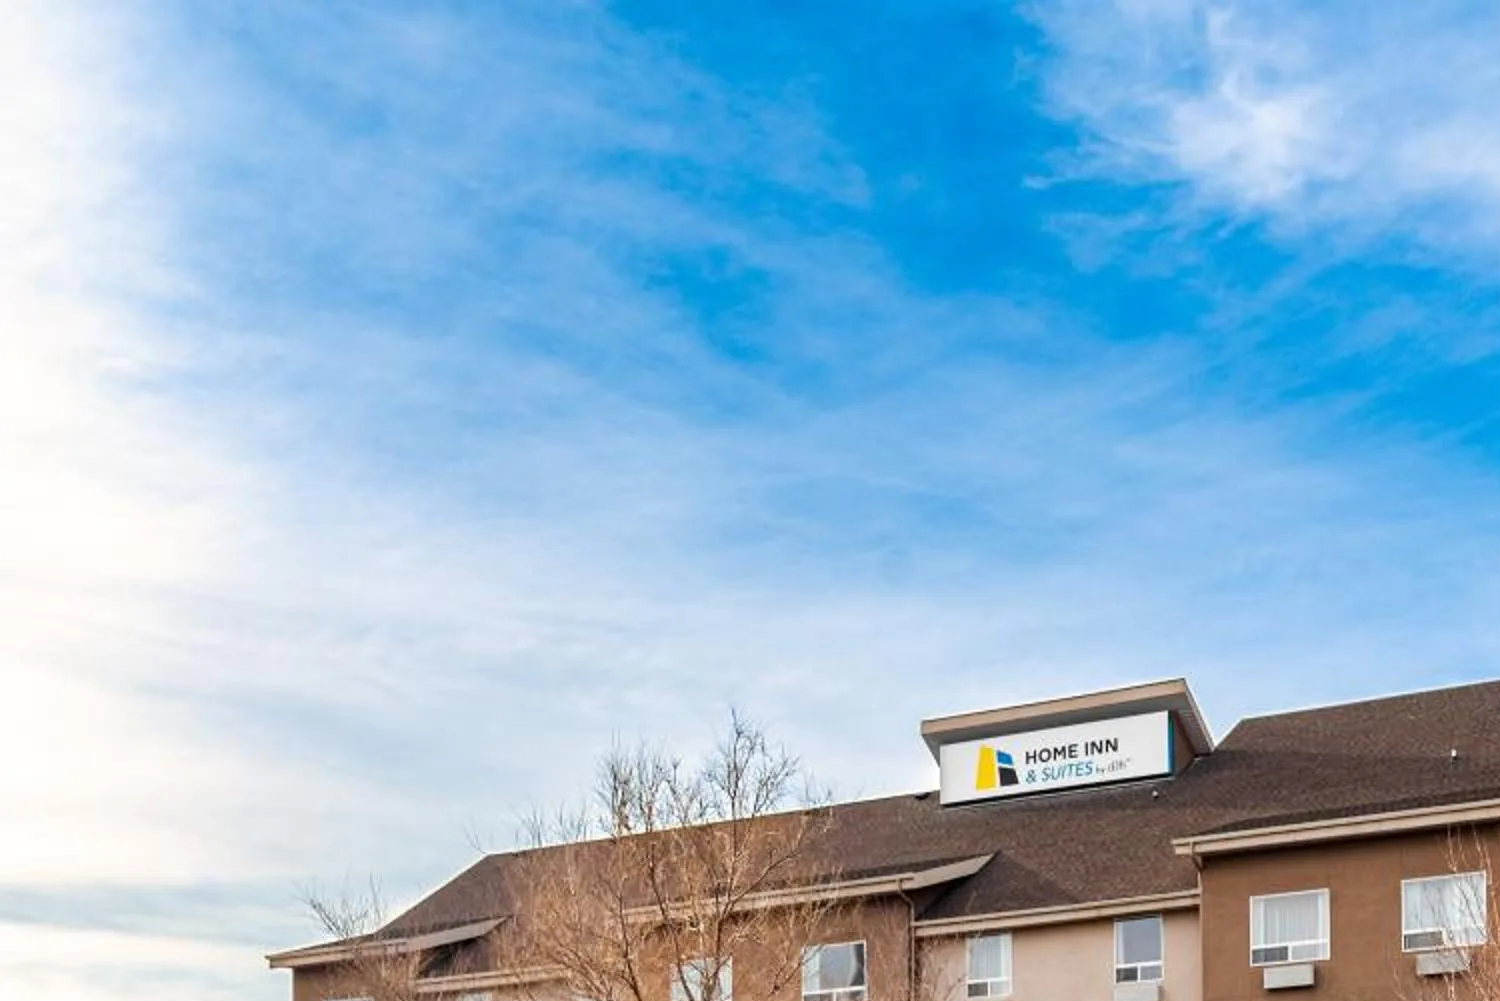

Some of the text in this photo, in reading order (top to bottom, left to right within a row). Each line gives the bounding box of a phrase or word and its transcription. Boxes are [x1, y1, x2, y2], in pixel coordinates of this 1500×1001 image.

[1025, 737, 1119, 765] HOME INN
[1025, 769, 1037, 784] &
[1041, 760, 1093, 782] SUITES
